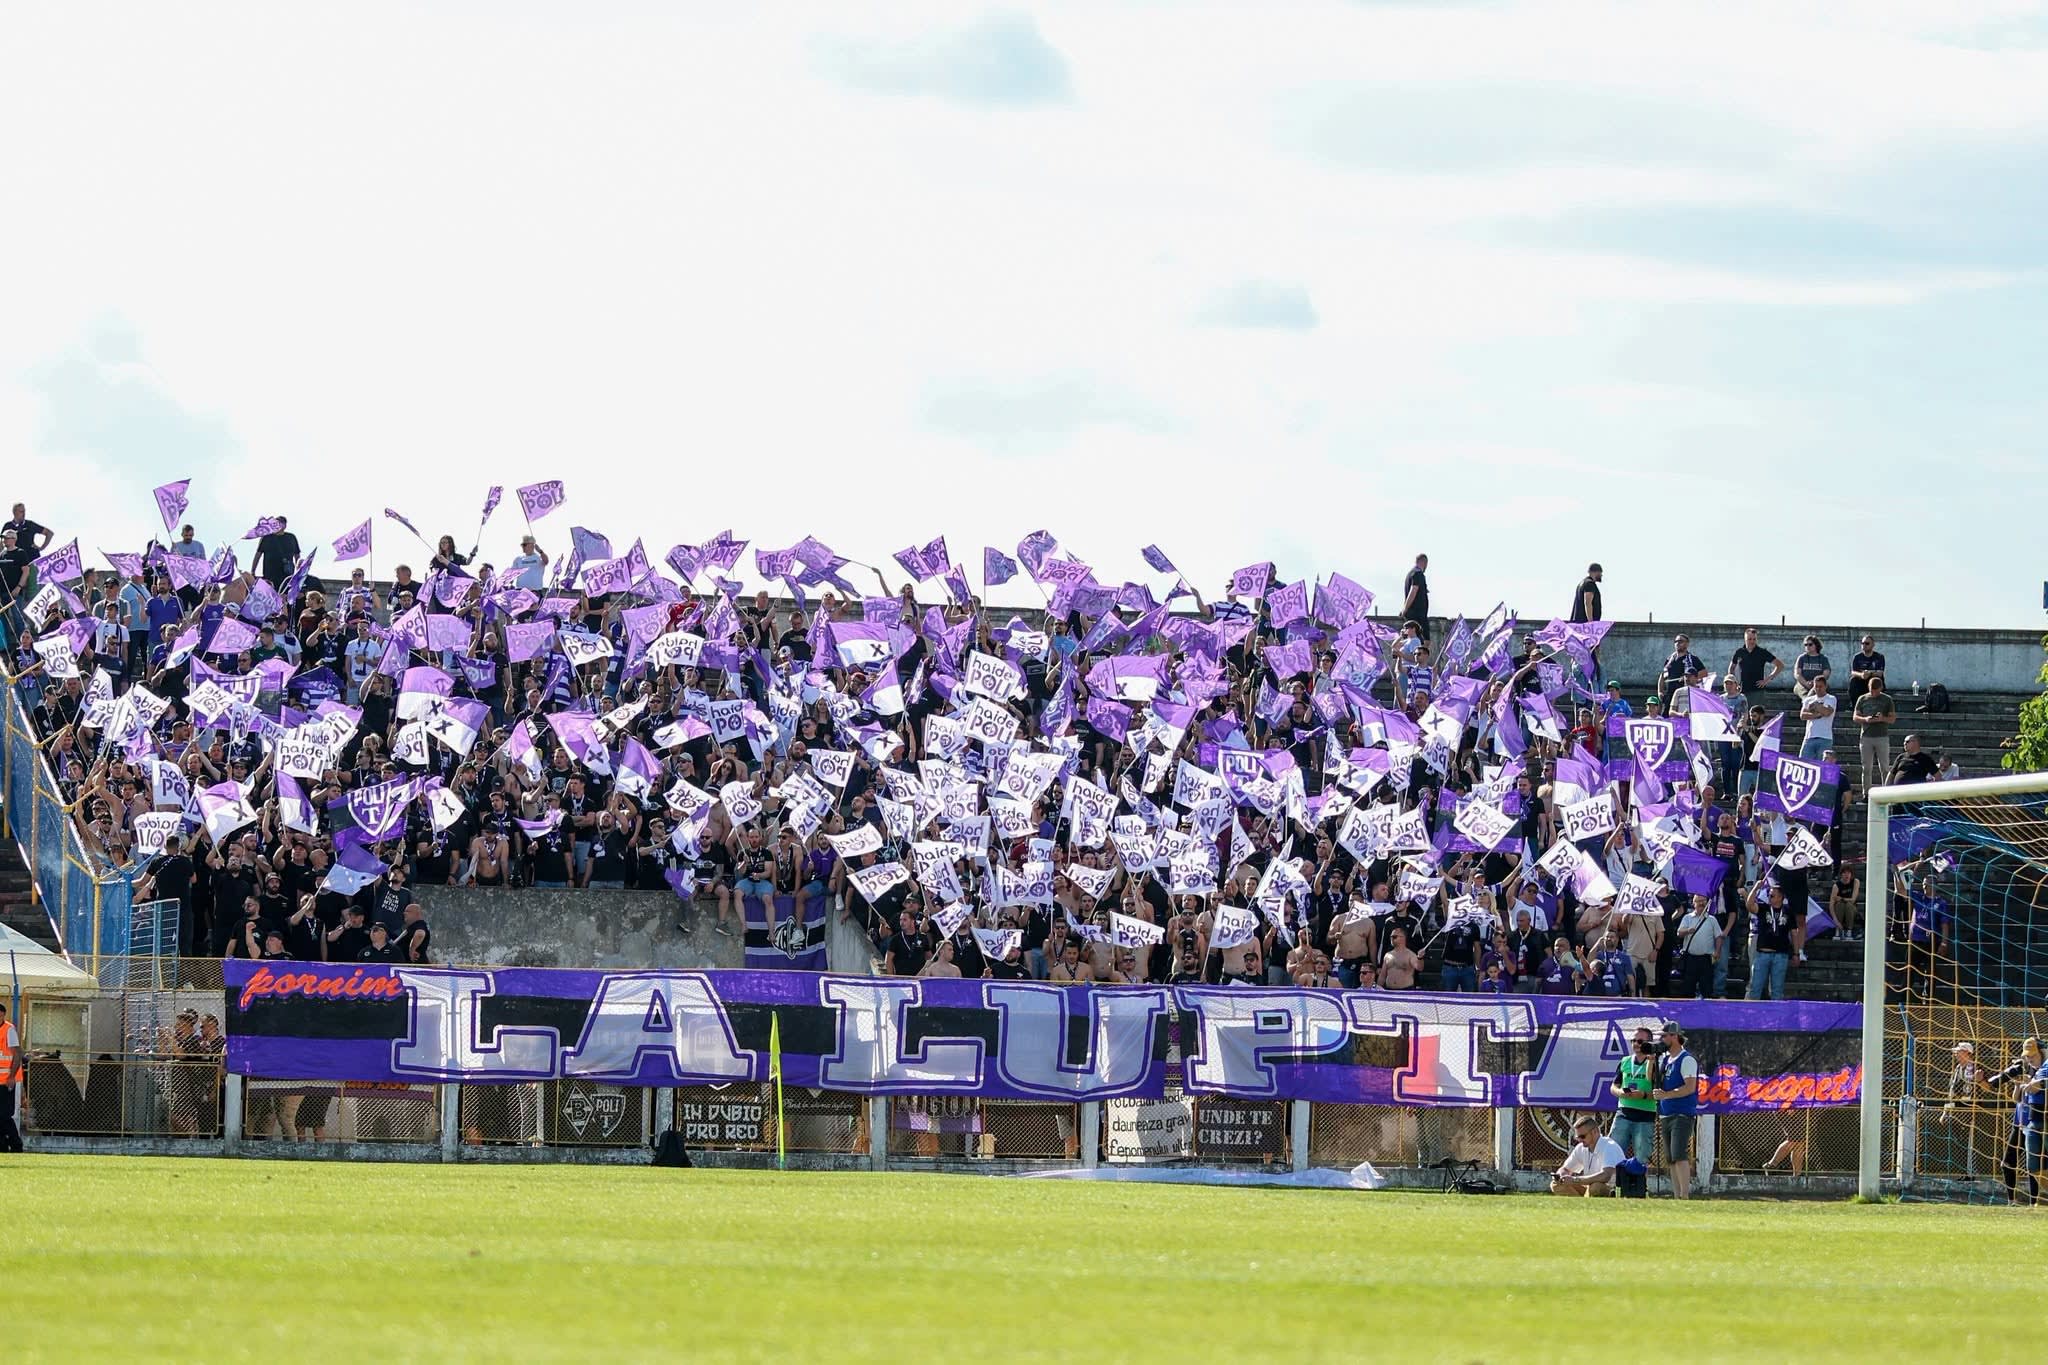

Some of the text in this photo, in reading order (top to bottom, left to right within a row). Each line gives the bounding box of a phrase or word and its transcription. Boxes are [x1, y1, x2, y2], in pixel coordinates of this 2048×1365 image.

[972, 655, 1013, 680] haide
[970, 669, 1012, 700] POLI
[974, 705, 1014, 729] haide
[969, 715, 1009, 744] POLI
[1633, 726, 1666, 744] POLI
[281, 742, 323, 758] haide
[1639, 743, 1658, 761] T
[281, 754, 322, 776] POLI
[1782, 763, 1813, 785] POLI
[1072, 780, 1113, 806] haide
[1785, 781, 1803, 801] T
[361, 807, 382, 824] T
[1566, 803, 1608, 820] haide
[1569, 815, 1613, 837] POLI
[914, 844, 960, 861] haide
[239, 966, 404, 1009] pornim
[390, 966, 1672, 1109] LA LUPTA
[596, 1099, 619, 1113] POLI
[1200, 1110, 1273, 1125] UNDE TE
[686, 1123, 759, 1140] PRO REO
[1198, 1128, 1264, 1145] CREZI?
